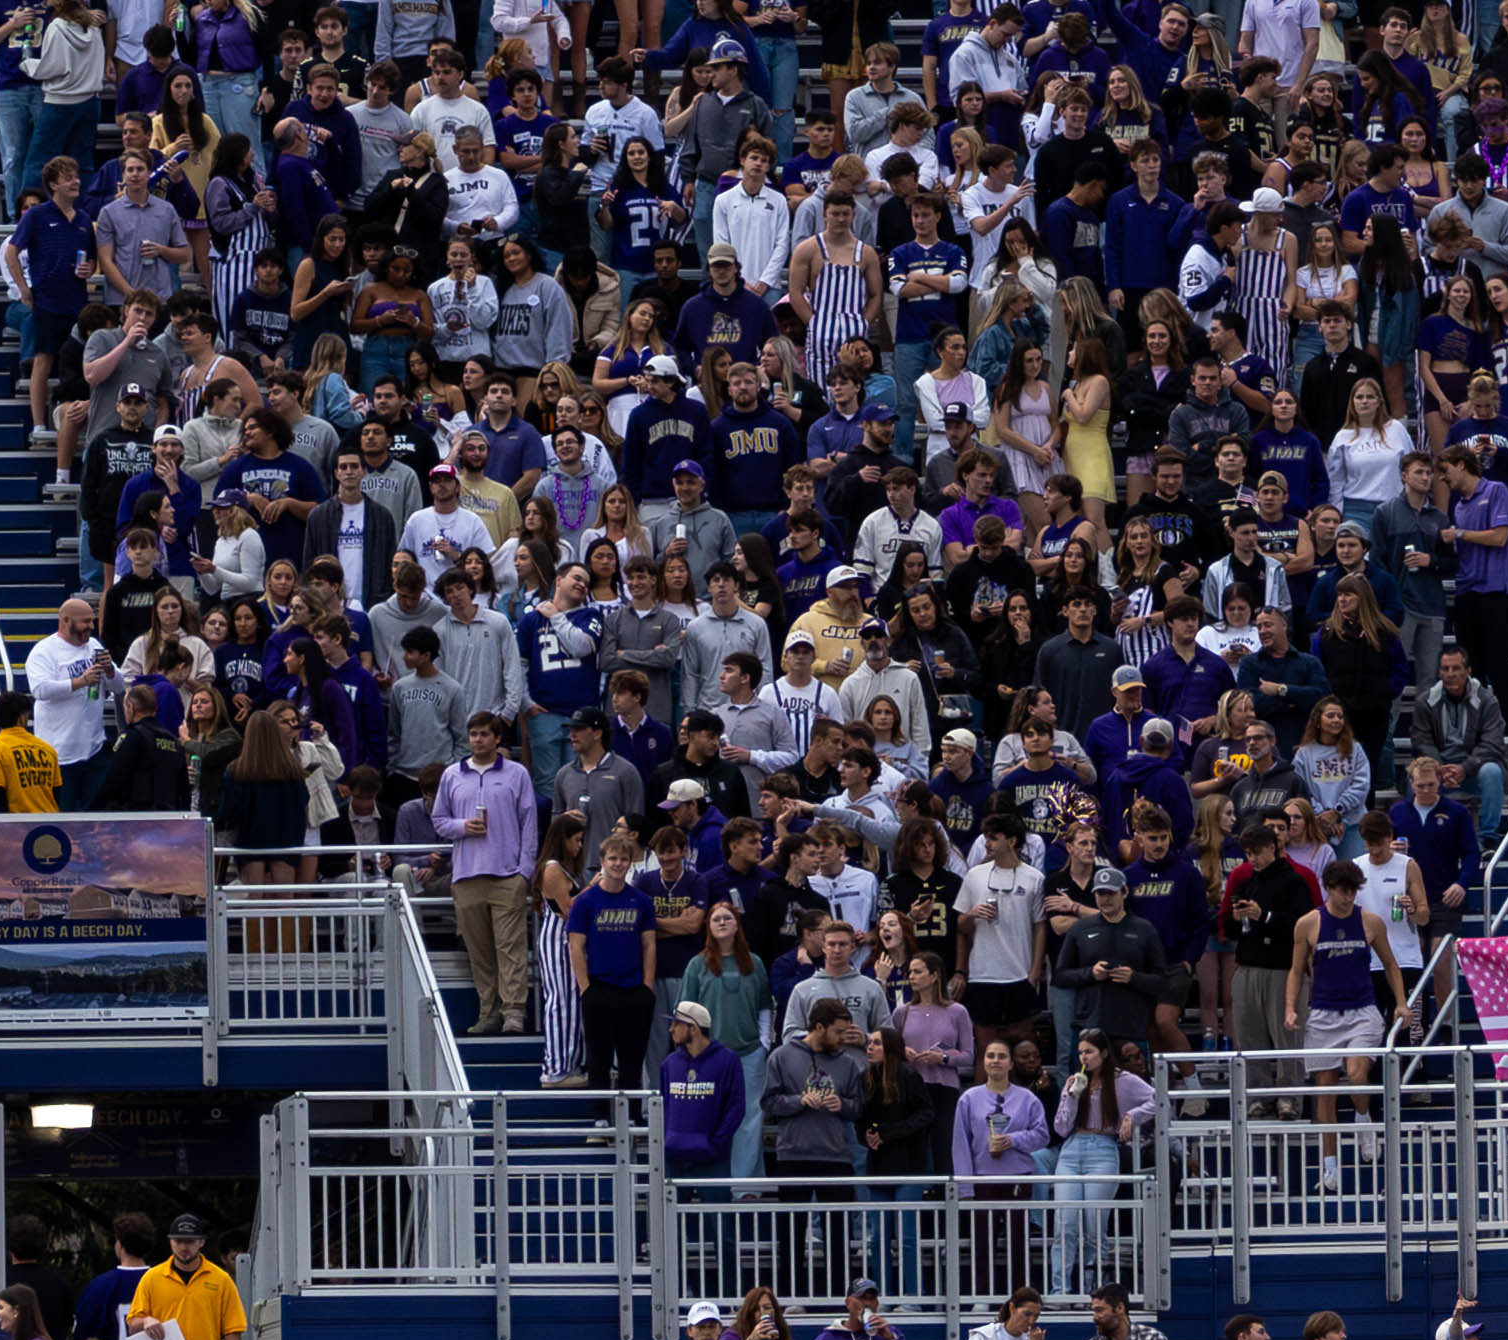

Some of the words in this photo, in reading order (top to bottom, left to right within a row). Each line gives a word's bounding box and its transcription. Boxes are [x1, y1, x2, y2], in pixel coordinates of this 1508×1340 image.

[1229, 118, 1244, 132] 24
[459, 181, 488, 193] JMU
[1187, 271, 1201, 286] 25
[726, 428, 778, 458] JMU
[786, 576, 820, 590] JMU
[156, 738, 176, 751] POLICE
[14, 748, 52, 769] R.M.C.
[20, 770, 52, 787] EVENTS
[1135, 882, 1174, 895] JMU
[654, 897, 690, 906] BLEED
[597, 910, 636, 924] JMU
[13, 926, 38, 939] DAY
[43, 926, 56, 938] IS
[59, 926, 69, 938] A
[72, 925, 114, 938] BEECH
[117, 924, 147, 938] DAY.
